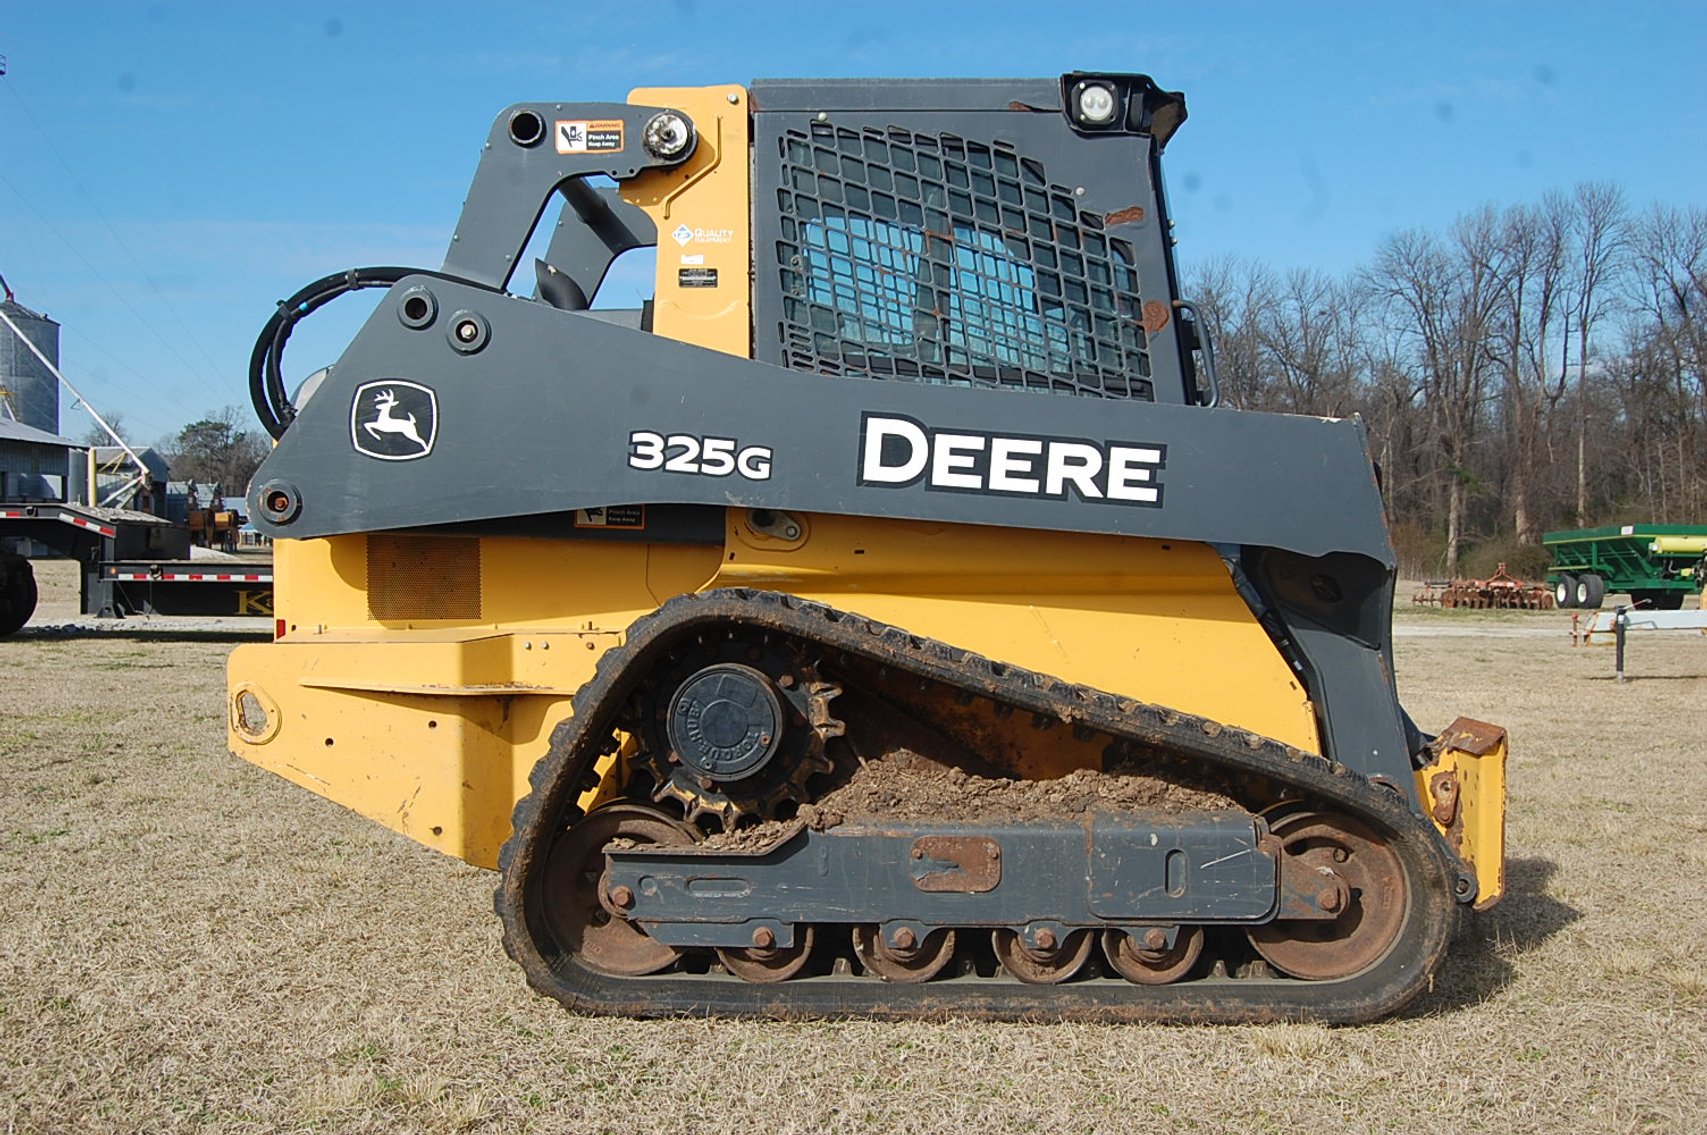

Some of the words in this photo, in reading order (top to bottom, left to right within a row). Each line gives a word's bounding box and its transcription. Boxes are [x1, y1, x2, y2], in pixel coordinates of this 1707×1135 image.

[588, 133, 605, 141] Pinch
[606, 133, 620, 141] Area
[694, 227, 735, 237] QUALITY
[628, 431, 773, 480] 325G
[861, 416, 1161, 503] DEERE
